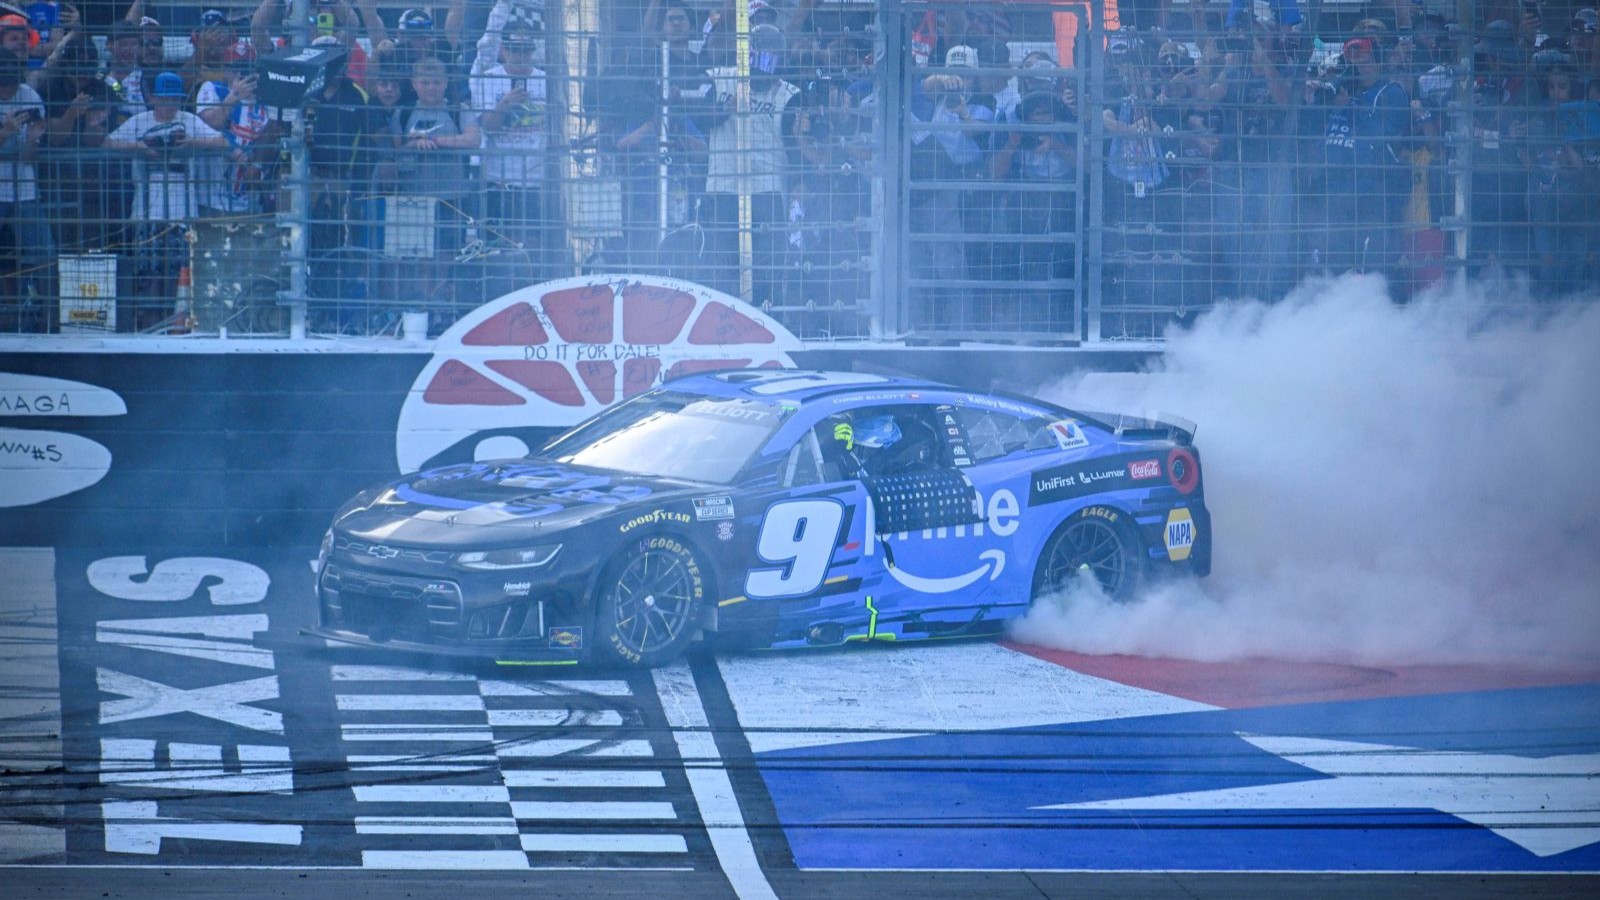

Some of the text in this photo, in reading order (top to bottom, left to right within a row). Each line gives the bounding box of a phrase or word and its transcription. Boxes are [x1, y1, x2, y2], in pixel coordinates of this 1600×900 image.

[268, 71, 305, 84] WHELEN
[525, 345, 548, 360] DO
[556, 344, 568, 360] IT
[576, 343, 607, 361] FOR
[613, 343, 661, 361] DALE!
[1036, 476, 1076, 492] UniFirst
[619, 509, 691, 533] GOODYEAR
[1081, 506, 1119, 523] EAGLE
[1168, 522, 1192, 547] NAPA
[744, 497, 845, 599] 9
[504, 581, 531, 591] Hendrick
[610, 633, 641, 664] EAGLE
[86, 555, 304, 856] TEXAS
